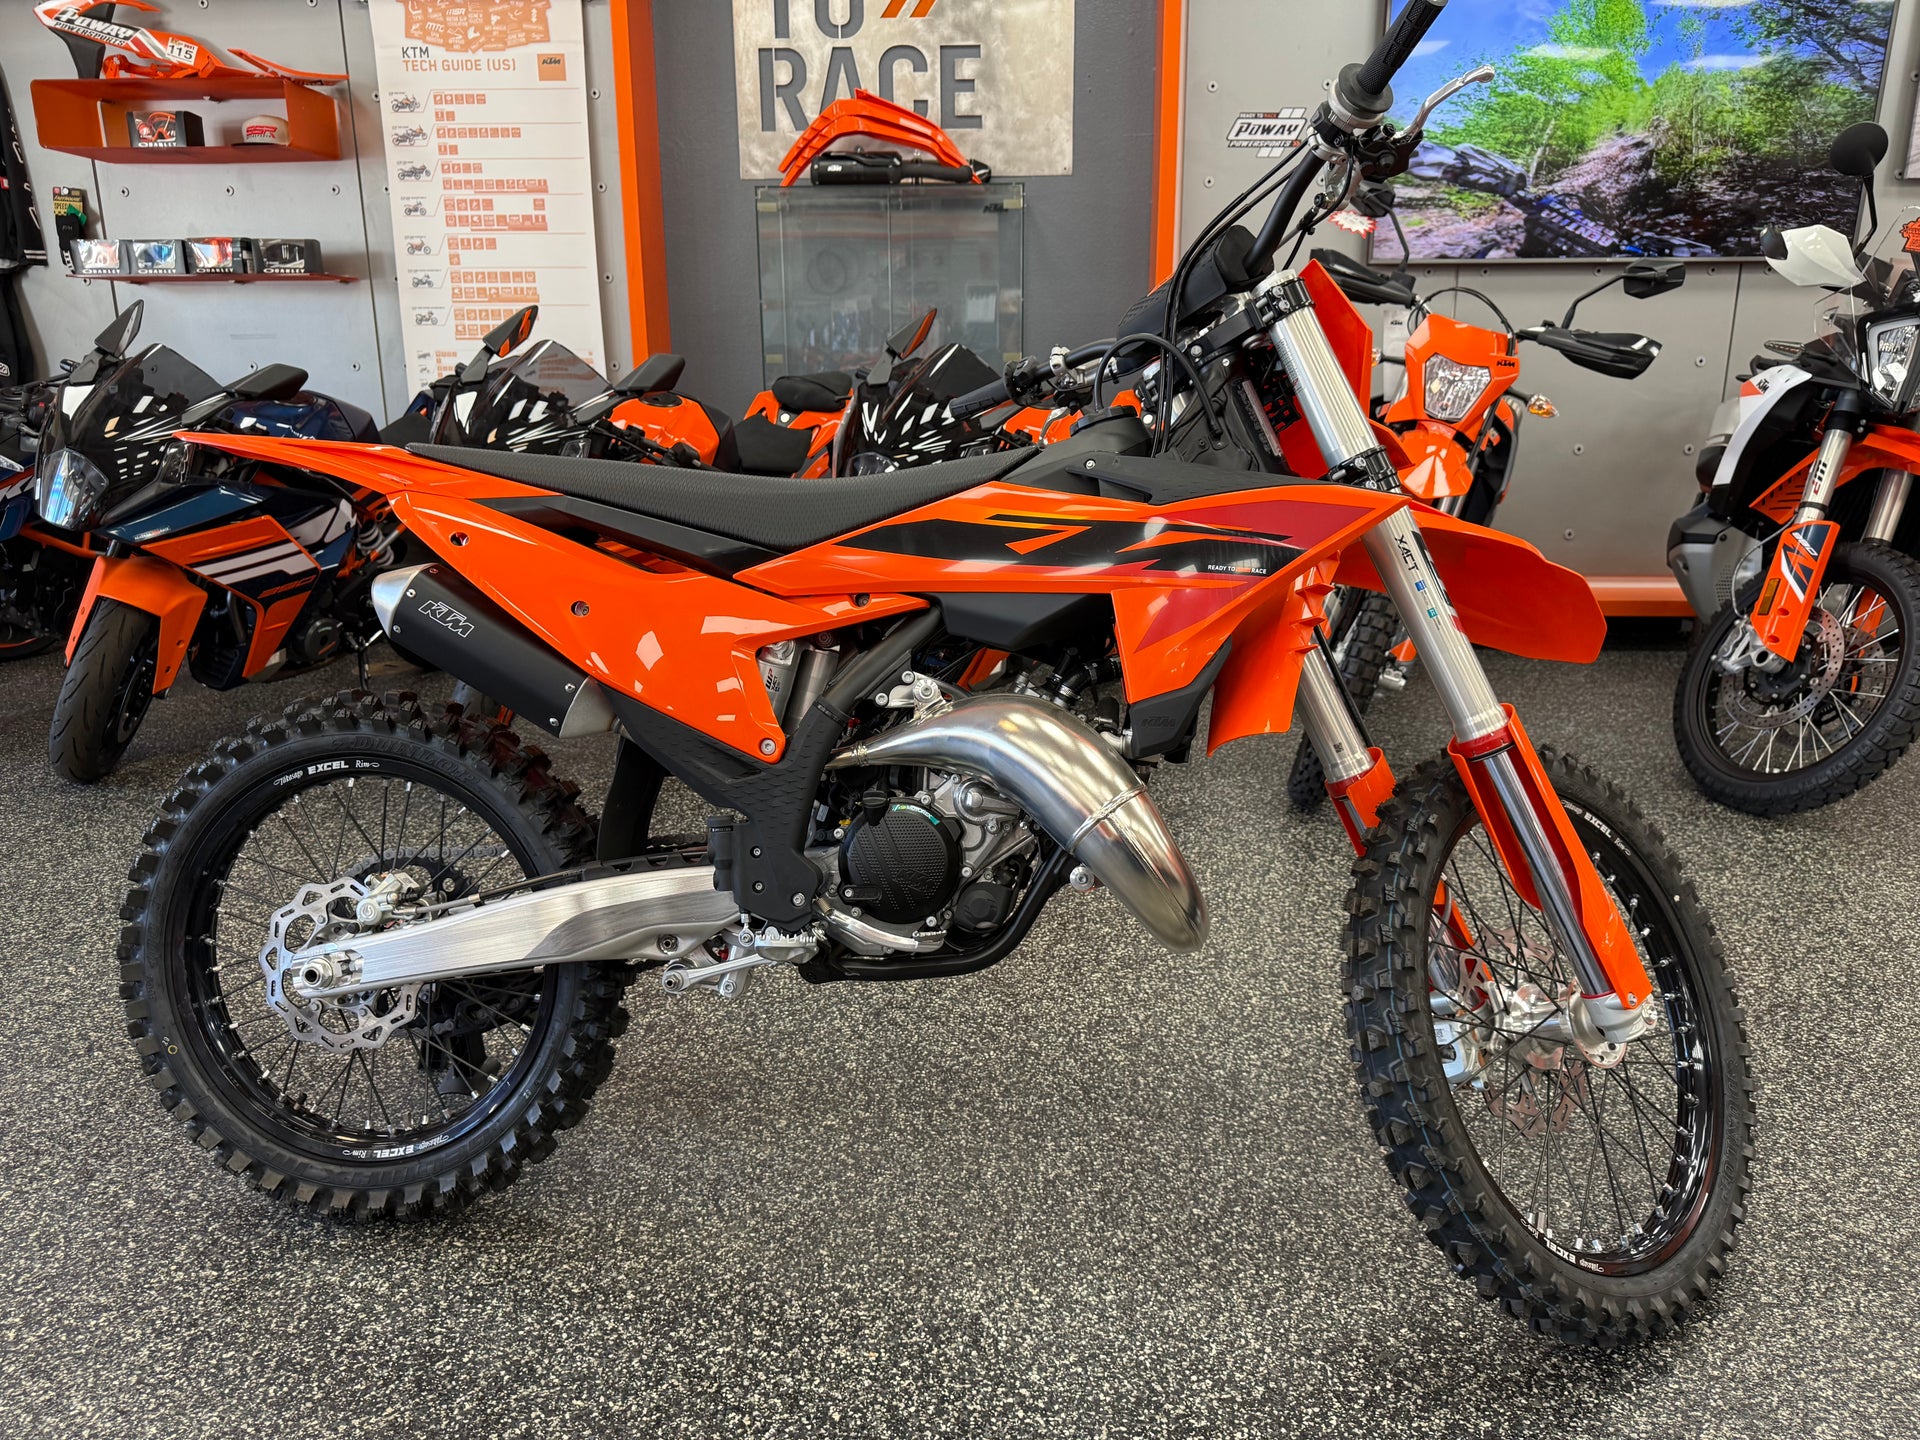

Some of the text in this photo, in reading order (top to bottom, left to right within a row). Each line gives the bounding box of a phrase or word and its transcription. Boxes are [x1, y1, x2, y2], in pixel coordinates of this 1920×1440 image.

[168, 44, 195, 60] 115
[401, 46, 430, 59] KTM
[402, 57, 516, 72] TECH GUIDE (US)
[758, 44, 983, 132] RACE
[1234, 122, 1299, 137] POWAY
[1756, 378, 1770, 394] KTM
[1395, 534, 1420, 571] XACT
[418, 599, 475, 638] KTM
[307, 760, 349, 776] EXCEL
[355, 759, 377, 769] Rim
[1583, 811, 1612, 839] EXCEL
[372, 1144, 415, 1159] EXCEL
[1543, 1236, 1577, 1264] EXCEL
